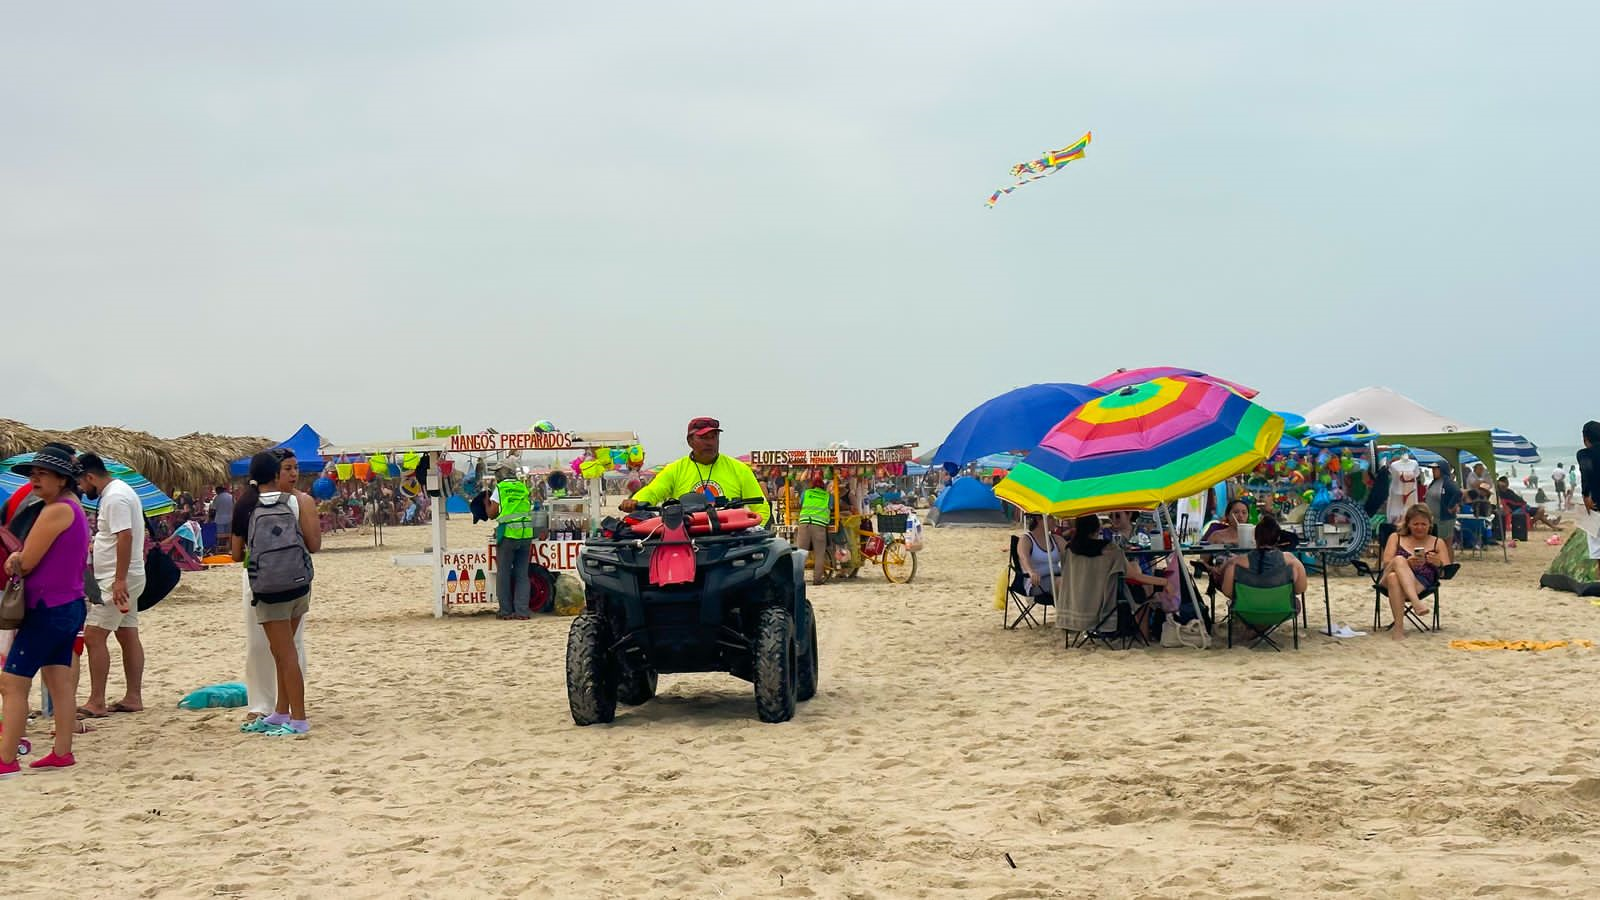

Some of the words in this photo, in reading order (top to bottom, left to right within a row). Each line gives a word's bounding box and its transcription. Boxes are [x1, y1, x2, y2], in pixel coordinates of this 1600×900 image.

[451, 433, 496, 449] MANGOS
[501, 432, 572, 449] PREPARADOS
[751, 450, 788, 464] ELOTES
[841, 449, 876, 463] TROLES
[444, 553, 487, 565] RASPAS
[446, 592, 487, 604] LECHE
